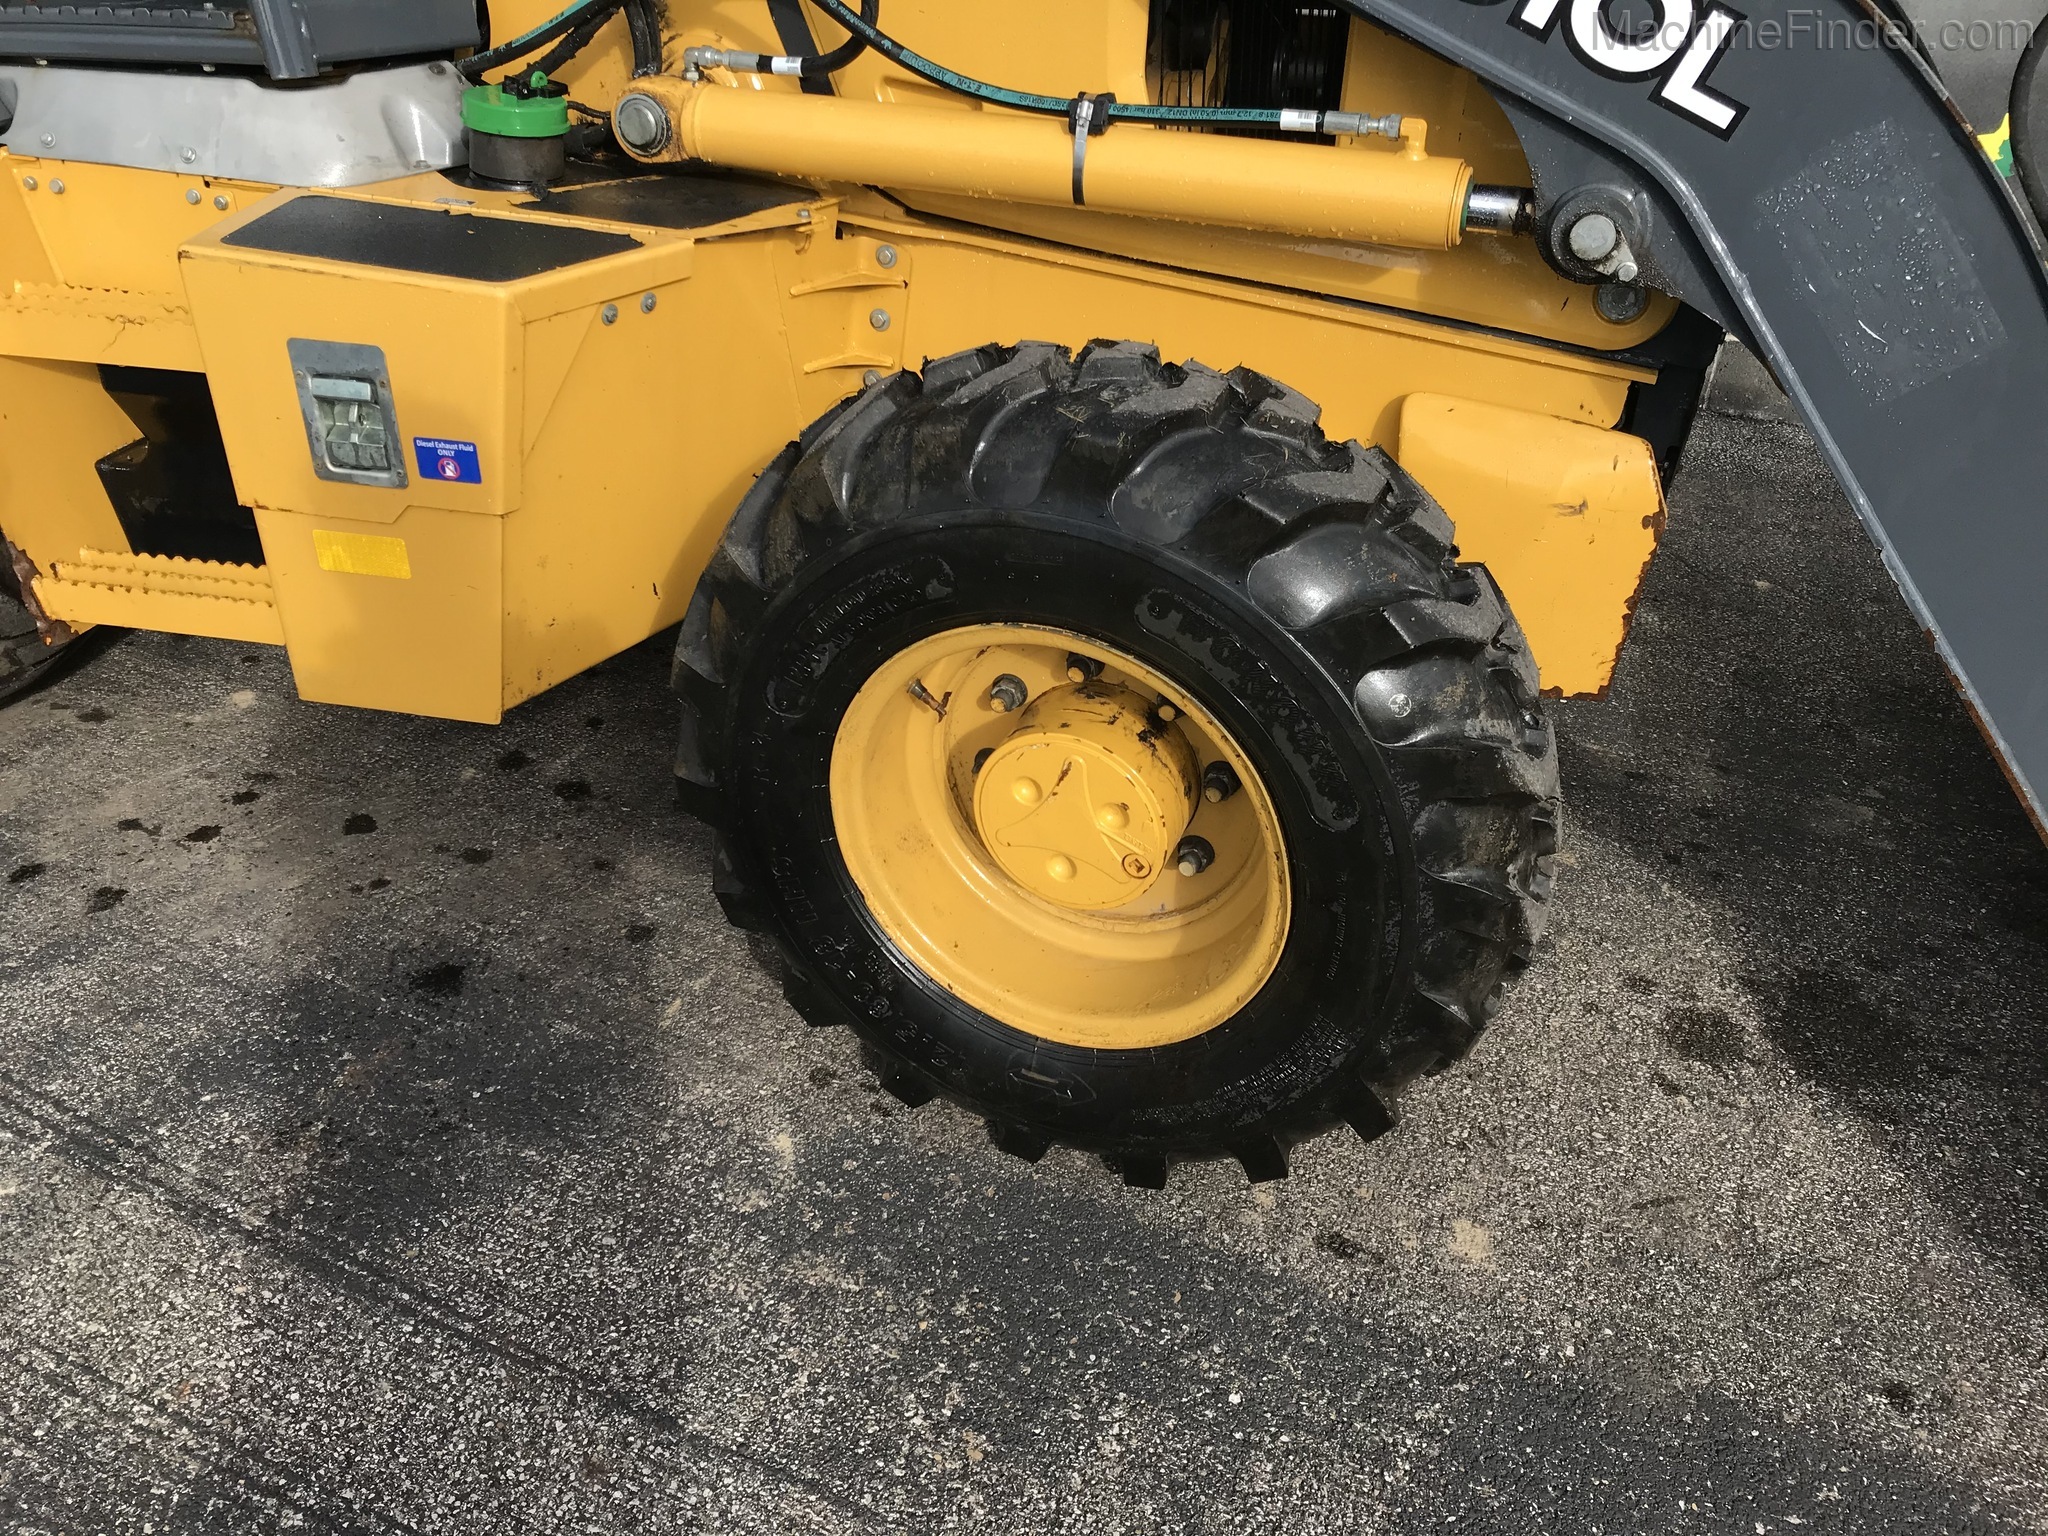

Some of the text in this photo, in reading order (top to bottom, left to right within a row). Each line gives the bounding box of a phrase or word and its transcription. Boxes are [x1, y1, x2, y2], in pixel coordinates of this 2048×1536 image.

[416, 439, 474, 452] Diesel Exhaust Fluid
[437, 448, 455, 457] ONLY
